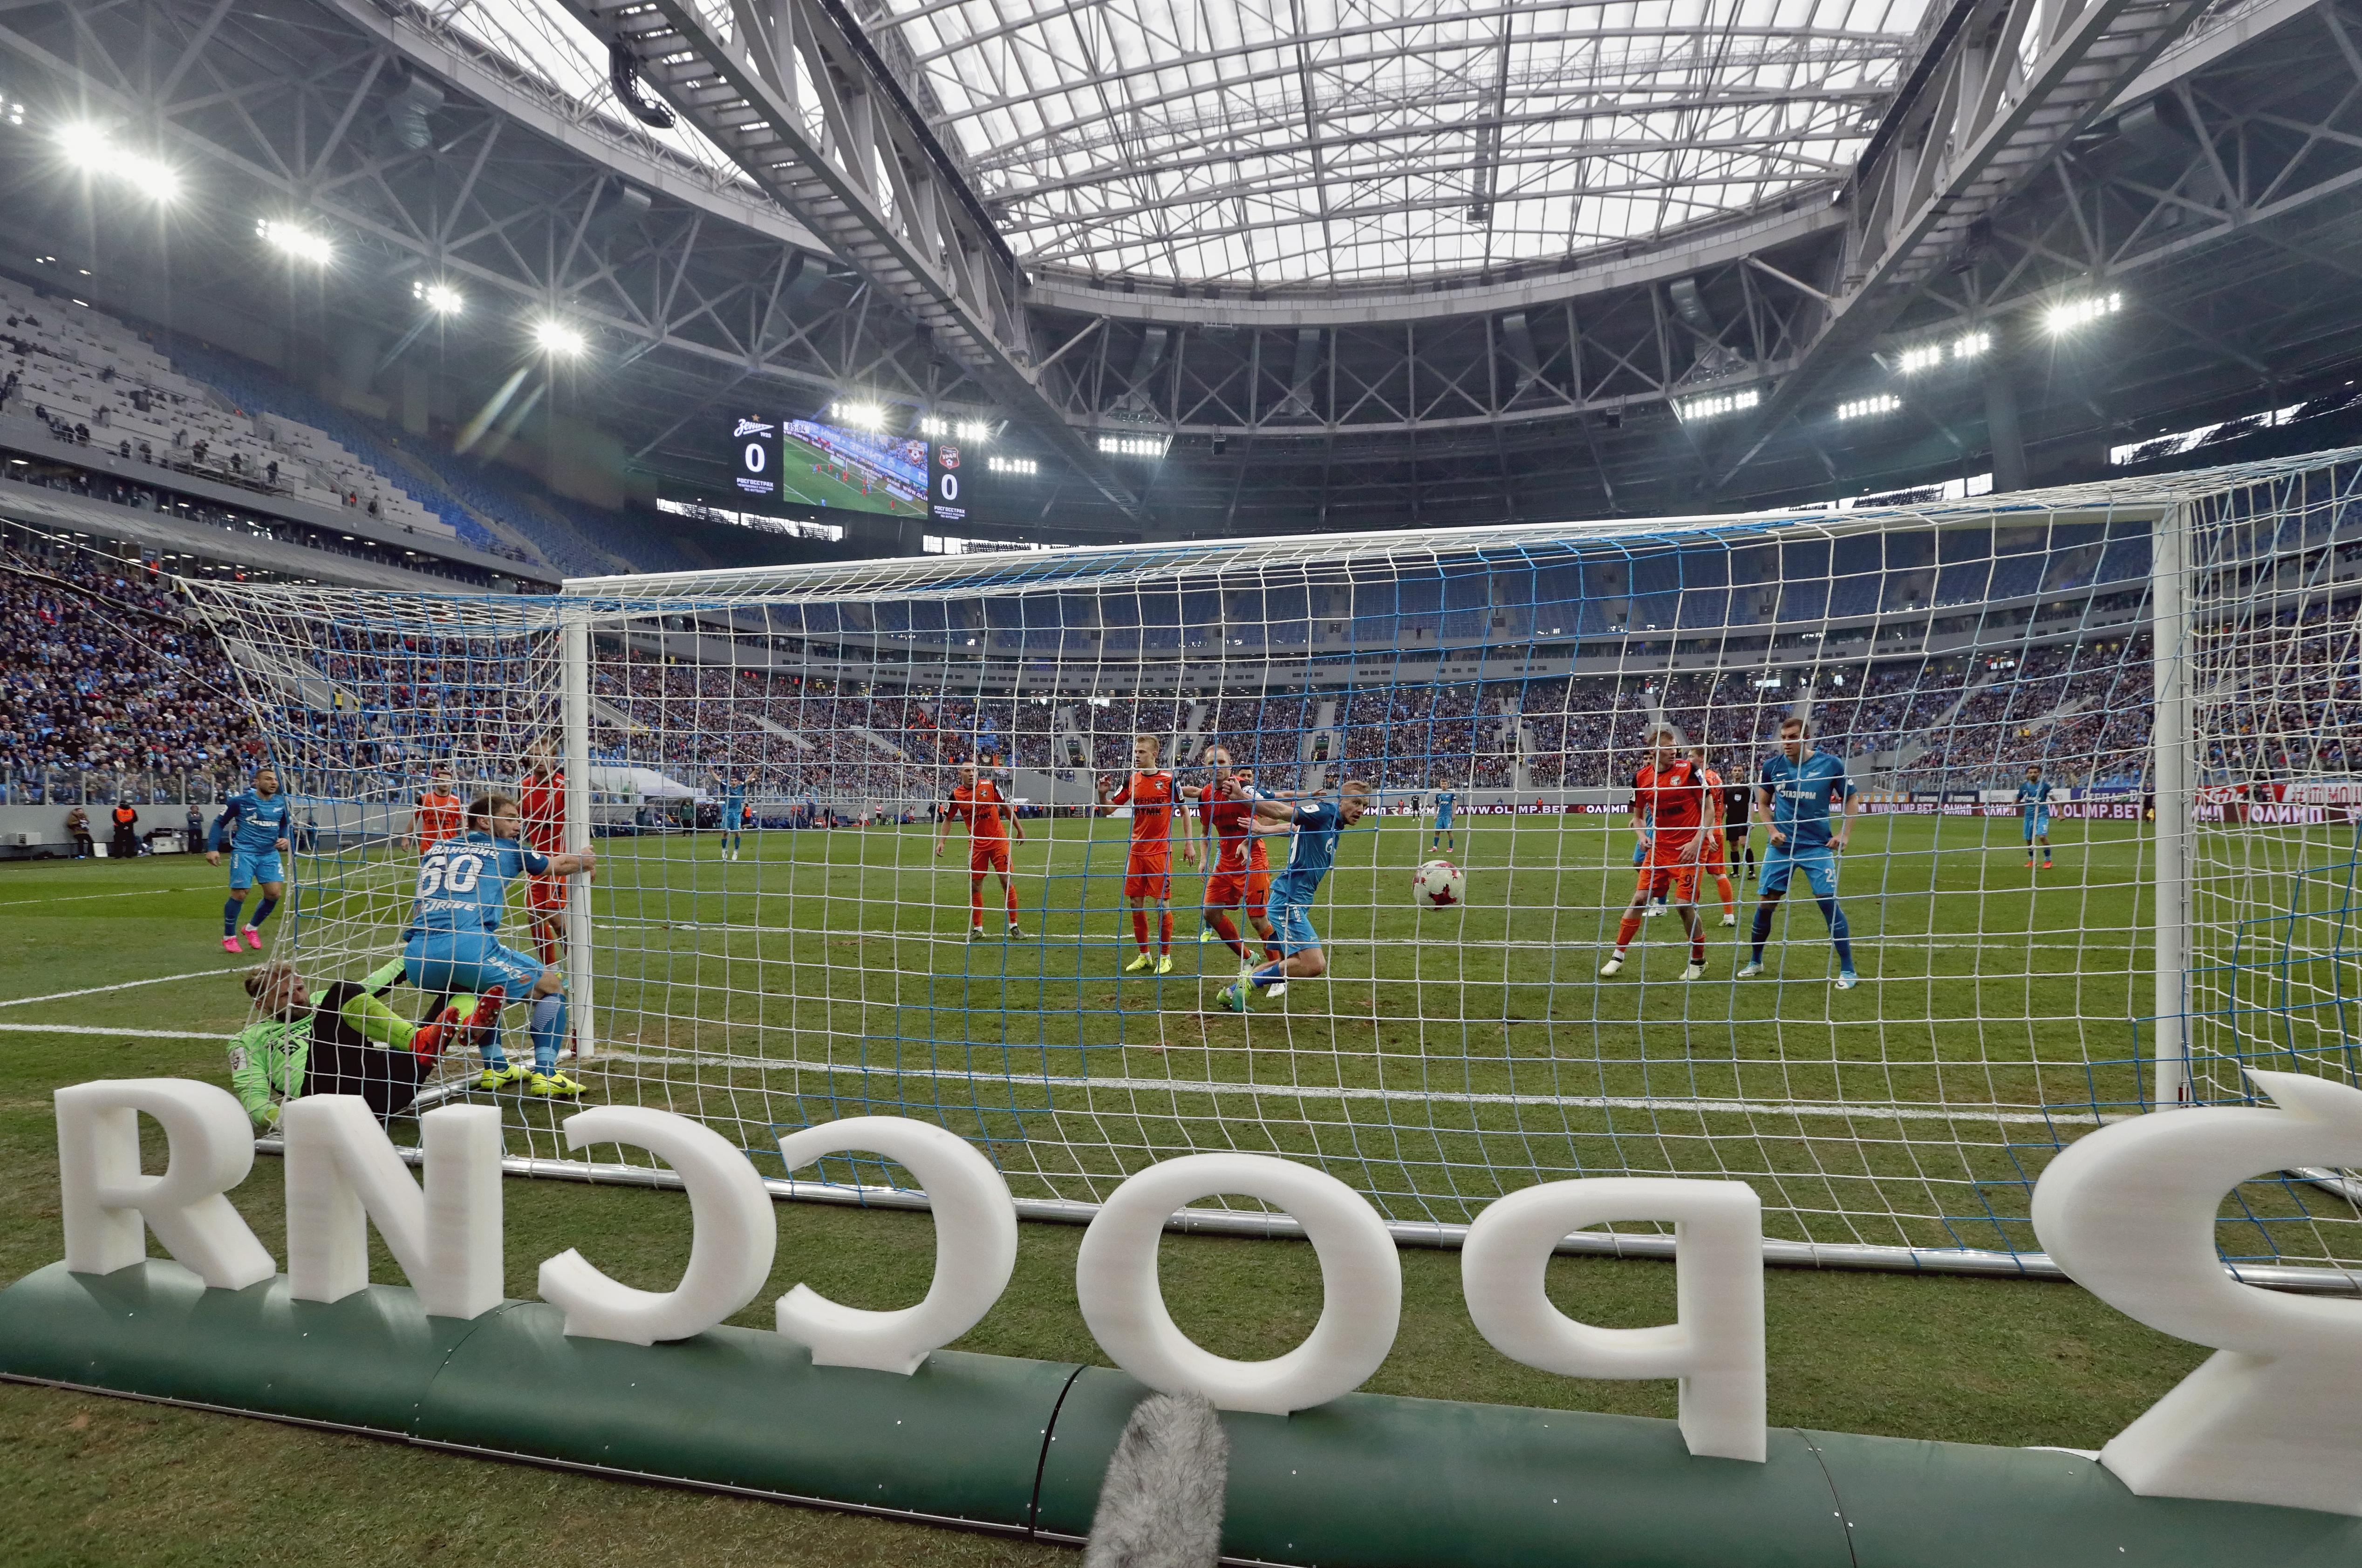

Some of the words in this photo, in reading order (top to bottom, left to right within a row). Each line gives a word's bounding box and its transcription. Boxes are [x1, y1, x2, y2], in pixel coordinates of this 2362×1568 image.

[788, 423, 806, 433] 85:04
[745, 443, 765, 472] 0
[736, 477, 774, 487] РОСГОССТРАХ
[941, 473, 958, 500] 0
[934, 505, 965, 514] РОСГОССТРАХ
[1786, 790, 1816, 799] ГАЗПРОМ
[1455, 805, 1569, 815] WWW.OLMP.BET
[1586, 804, 1628, 813] ОЛИМП
[1870, 803, 1933, 814] WWWOLIMPBET
[1944, 804, 1972, 815] ОЛИМП
[2252, 805, 2324, 824] ОЛИМП
[416, 854, 484, 897] 60
[1256, 890, 1265, 905] 7
